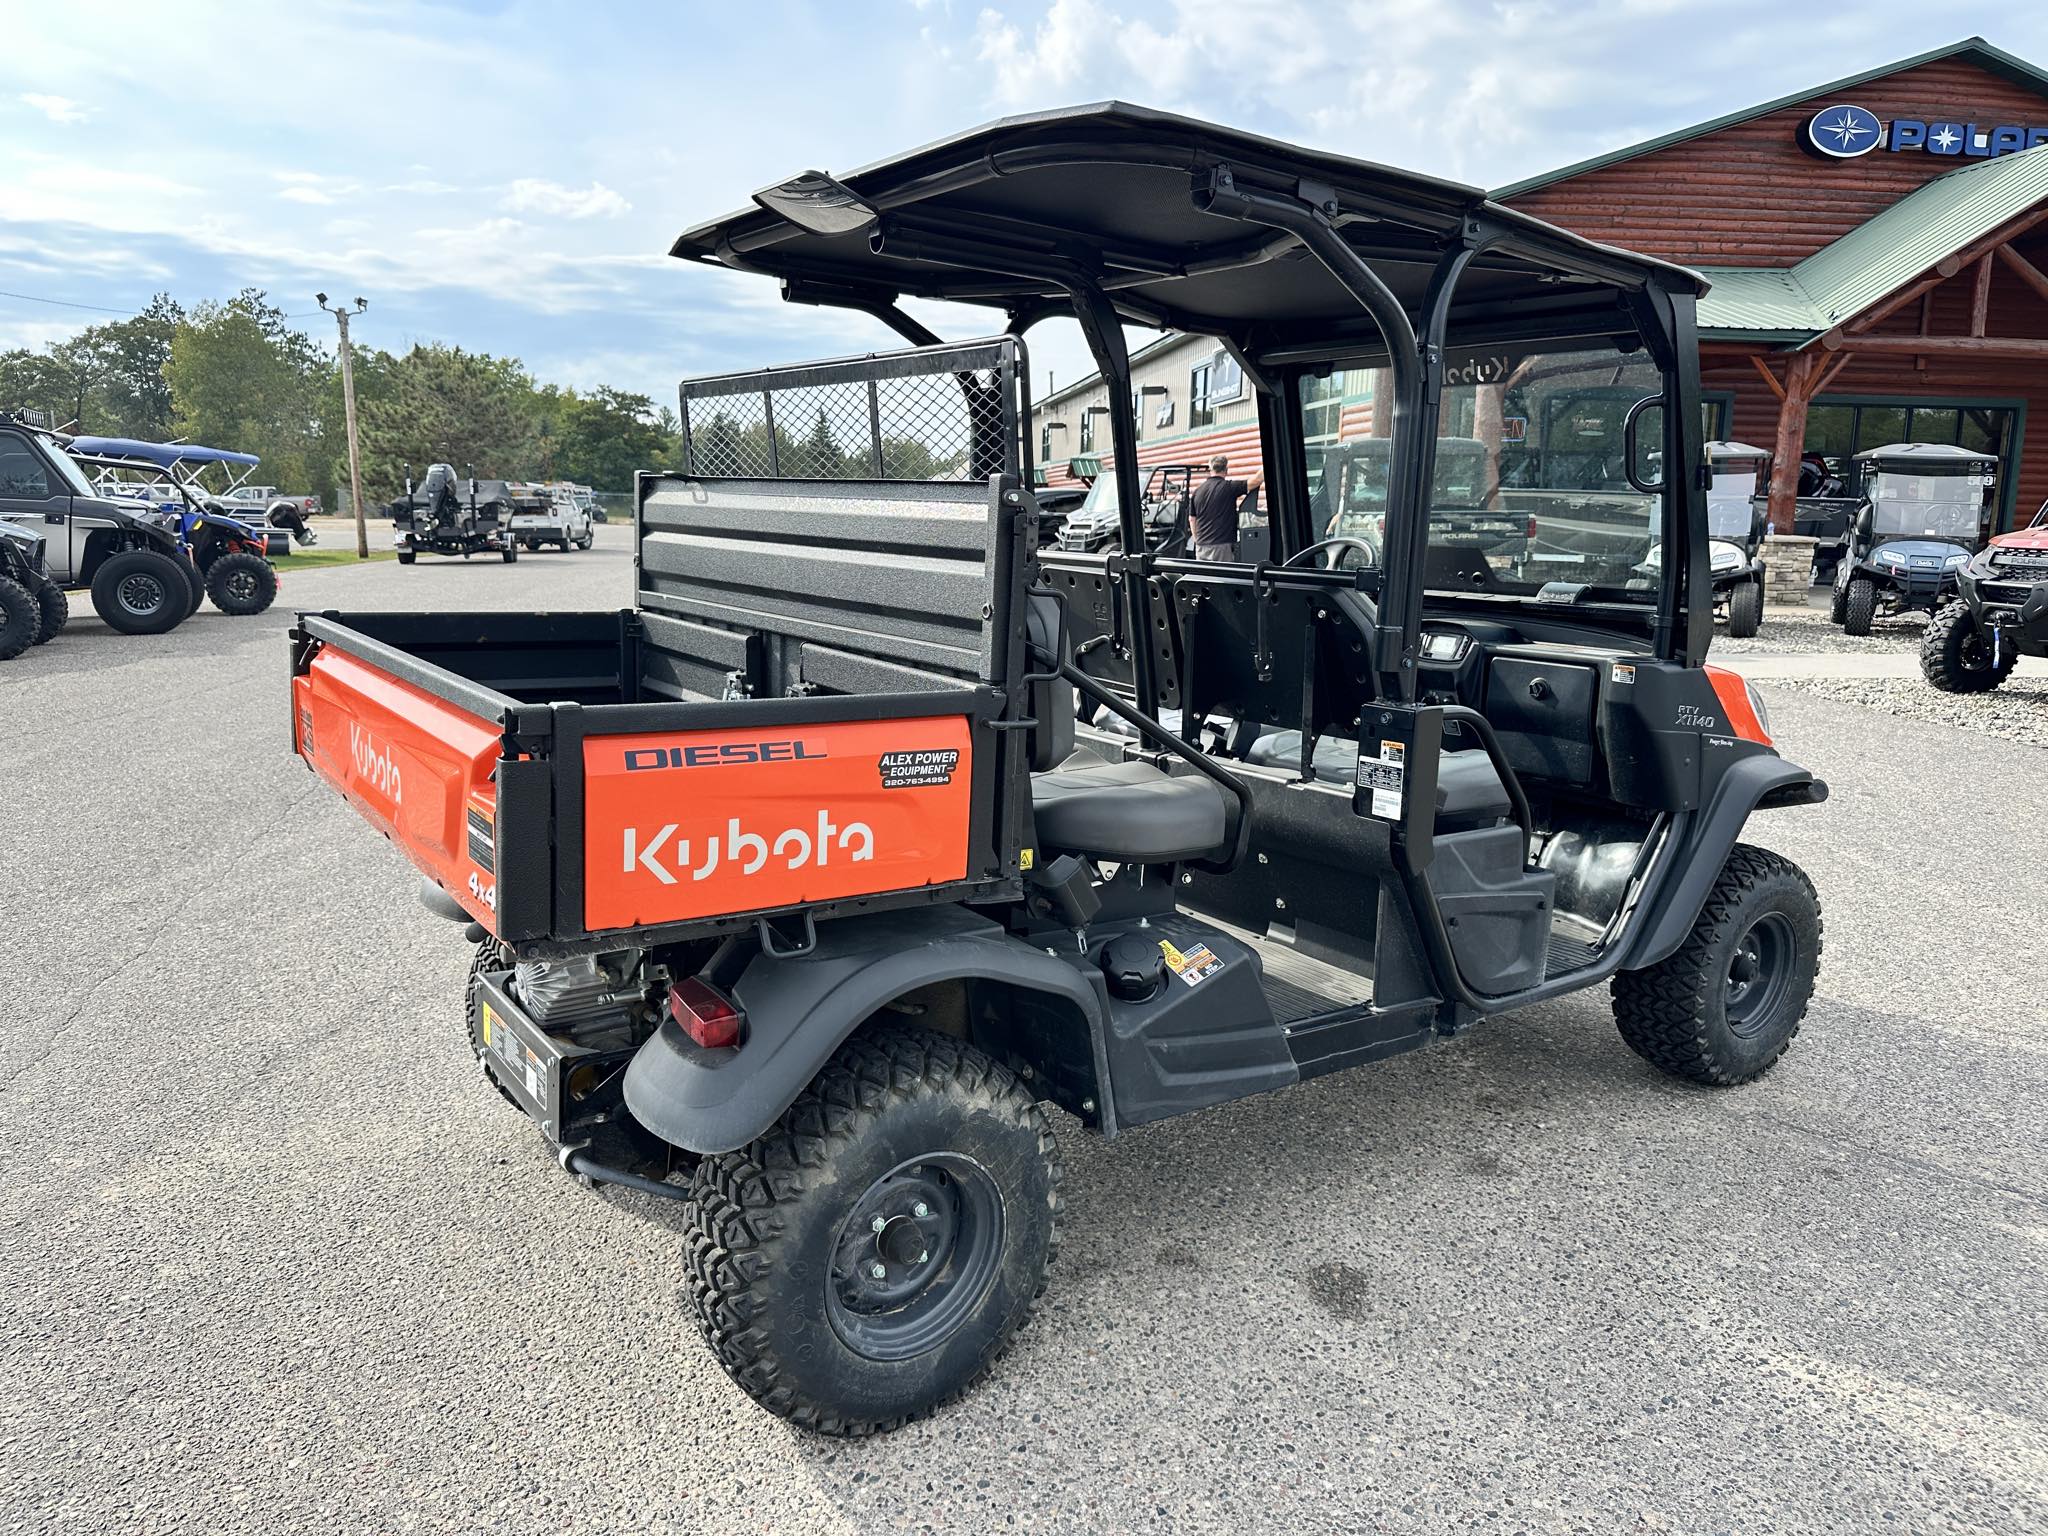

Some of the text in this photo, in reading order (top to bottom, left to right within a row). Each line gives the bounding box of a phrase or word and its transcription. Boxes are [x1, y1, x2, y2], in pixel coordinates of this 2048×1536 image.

[1678, 705, 1699, 714] RTV
[1675, 714, 1715, 727] X1140
[624, 740, 828, 771] DIESEL
[881, 752, 957, 766] ALEX POWER
[350, 721, 402, 805] Kubota
[890, 764, 948, 776] EQUIPMENT
[885, 776, 949, 785] 320-763-4994
[623, 809, 874, 885] Kubota
[469, 872, 496, 913] 4x4
